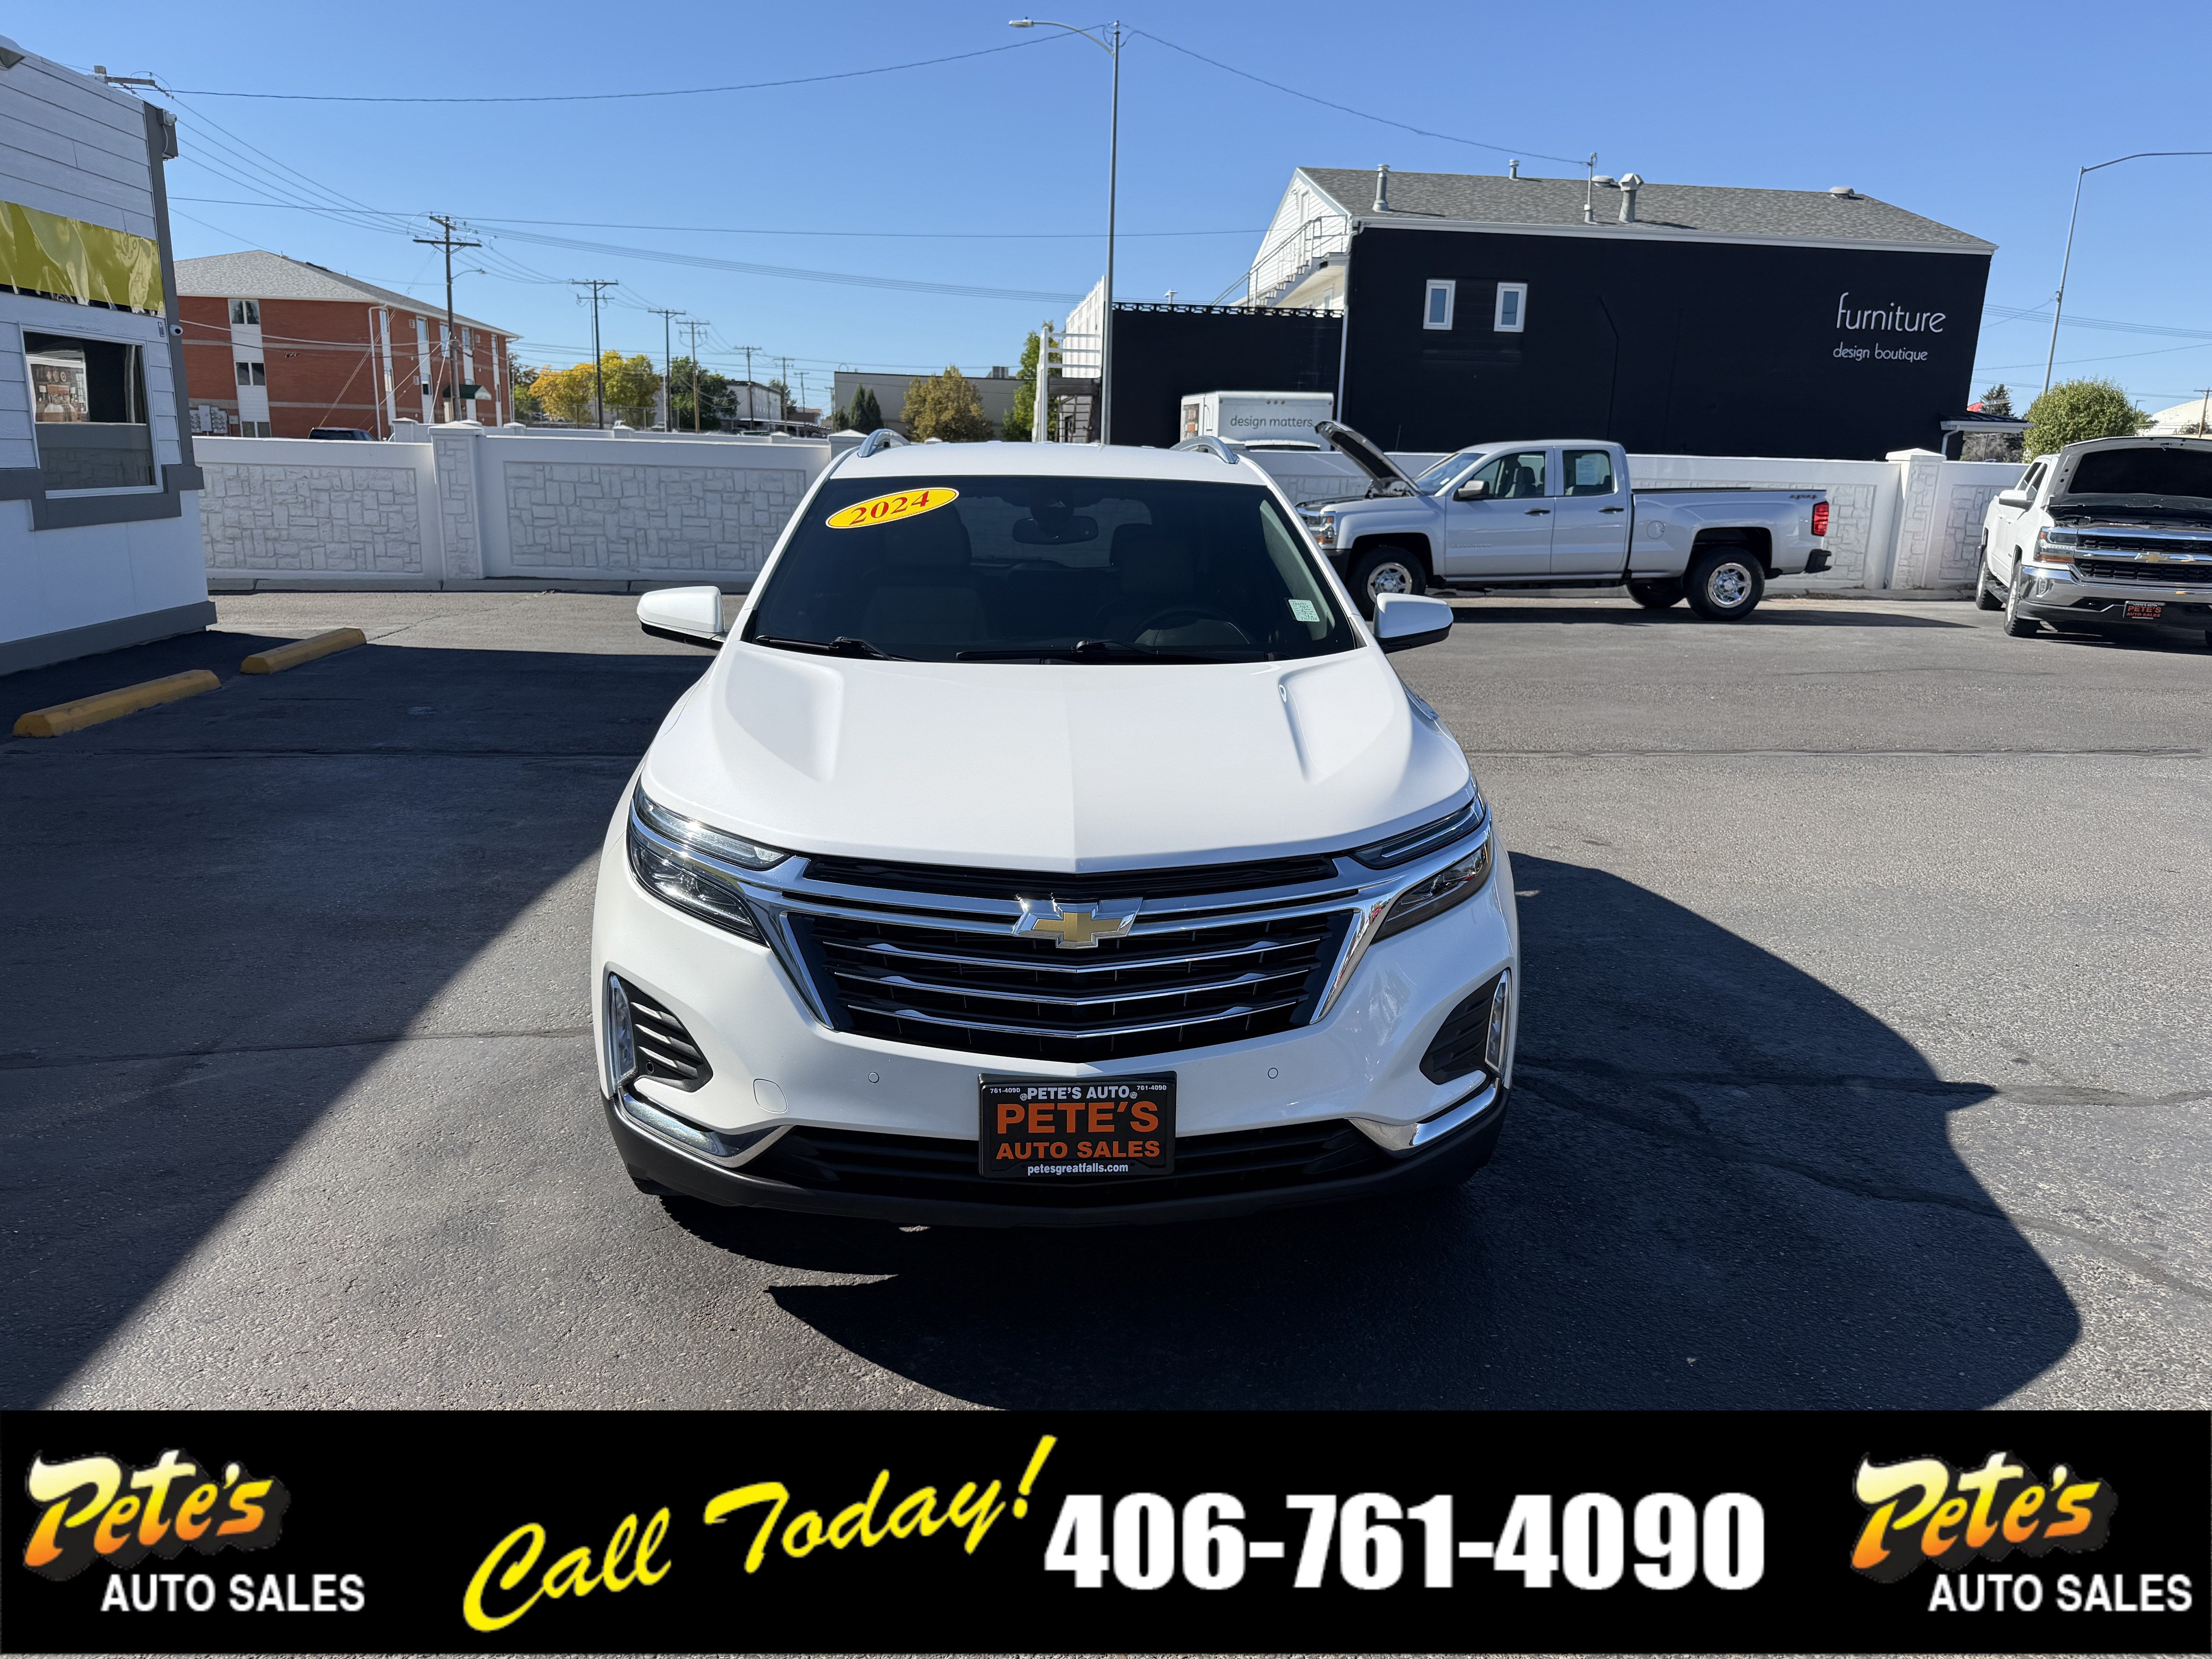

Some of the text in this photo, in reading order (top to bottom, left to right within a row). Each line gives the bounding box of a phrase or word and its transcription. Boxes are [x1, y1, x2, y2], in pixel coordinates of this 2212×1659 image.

[1836, 292, 1946, 333] furniture
[1833, 341, 1928, 363] design boutique
[1230, 415, 1313, 429] design matters
[849, 491, 929, 526] 2024
[1027, 1085, 1130, 1100] PETE'S AUTO
[997, 1101, 1159, 1134] PETE'S
[996, 1140, 1160, 1160] AUTO SALES
[1027, 1163, 1129, 1176] petesgreatfalls.com
